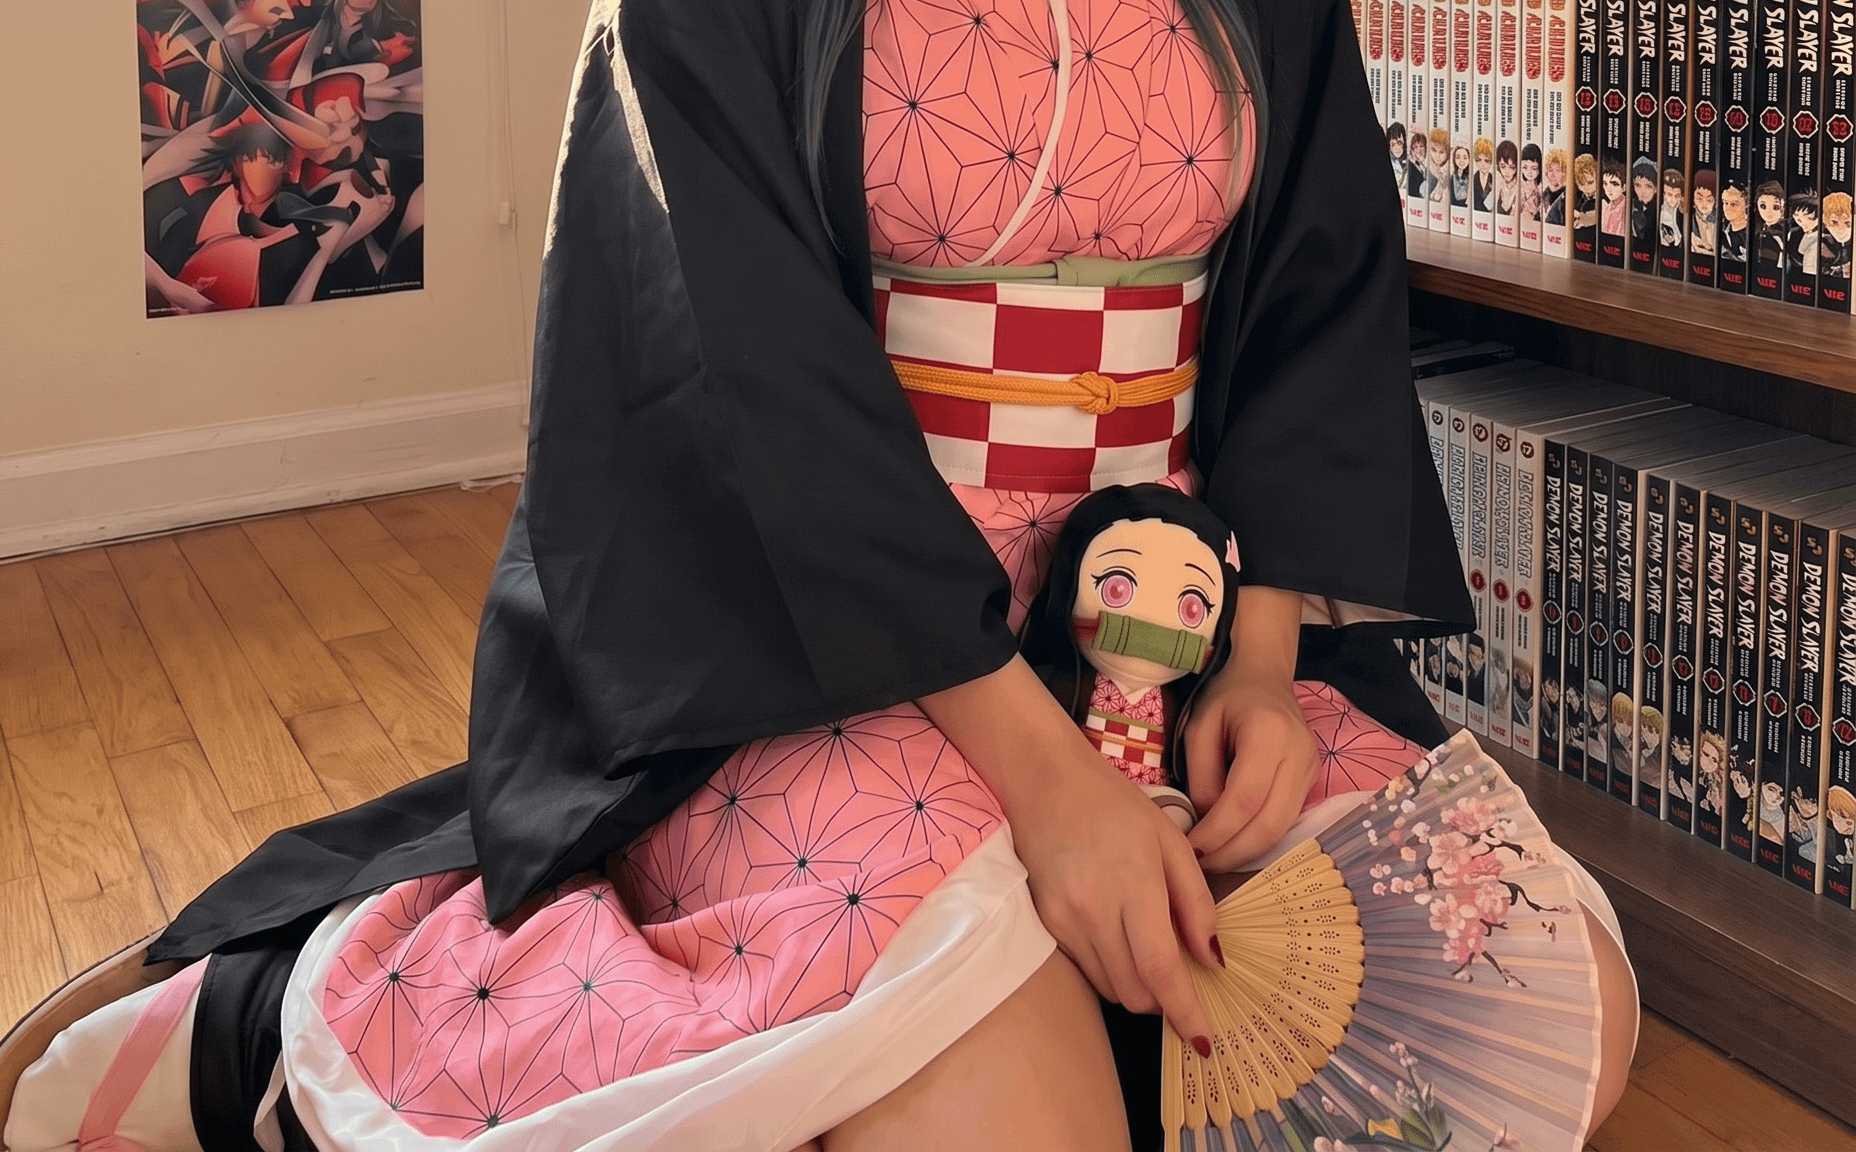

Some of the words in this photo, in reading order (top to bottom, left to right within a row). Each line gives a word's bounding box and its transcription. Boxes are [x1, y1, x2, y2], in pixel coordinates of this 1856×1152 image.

[1606, 0, 1624, 56] SLAYER
[1638, 0, 1656, 58] SLAYER
[1667, 3, 1686, 62] SLAYER
[1697, 4, 1716, 65] SLAYER
[1728, 8, 1748, 70] SLAYER
[1763, 6, 1785, 69] SLAYER
[1796, 8, 1818, 74] SLAYER
[1830, 11, 1854, 77] SLAYER
[1546, 475, 1560, 527] DEMON
[1568, 482, 1583, 534] DEMON
[1592, 491, 1608, 542] DEMON
[1617, 500, 1632, 551] DEMON
[1546, 524, 1560, 573] SLAYER
[1568, 532, 1582, 582] SLAYER
[1647, 512, 1664, 563] DEMON
[1676, 520, 1694, 574] DEMON
[1708, 531, 1726, 585] DEMON
[1592, 542, 1607, 594] SLAYER
[1616, 551, 1632, 602] SLAYER
[1647, 563, 1663, 614] SLAYER
[1738, 541, 1756, 596] DEMON
[1769, 550, 1789, 606] DEMON
[1802, 562, 1822, 618] DEMON
[1676, 574, 1693, 624] SLAYER
[1707, 585, 1724, 638] SLAYER
[1736, 596, 1756, 650] SLAYER
[1840, 572, 1856, 630] DEMON
[1768, 606, 1788, 660] SLAYER
[1800, 618, 1820, 674] SLAYER
